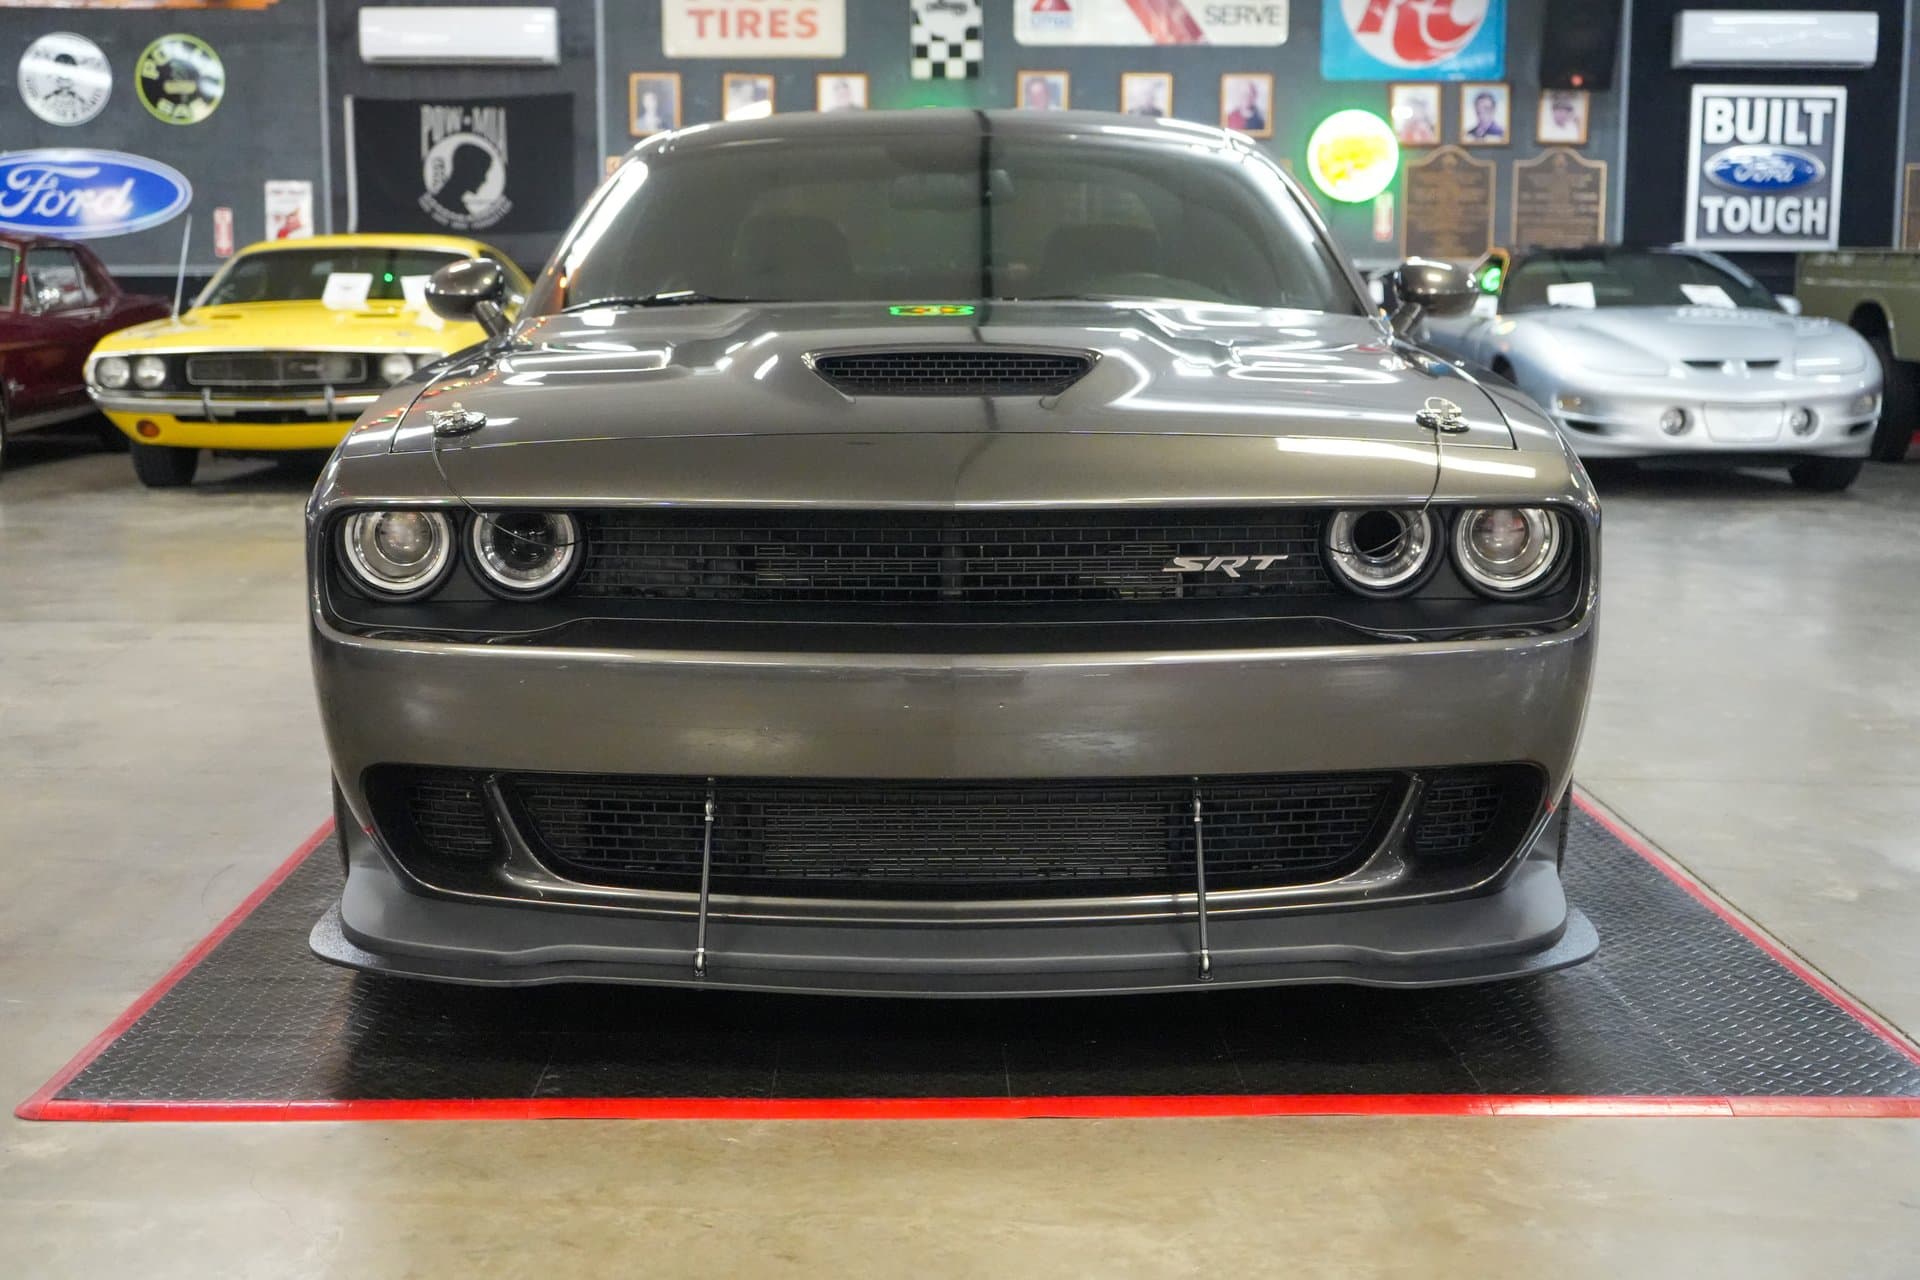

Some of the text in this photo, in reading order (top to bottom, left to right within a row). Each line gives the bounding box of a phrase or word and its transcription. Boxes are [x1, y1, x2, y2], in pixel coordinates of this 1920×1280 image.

[687, 8, 819, 38] TIRES
[1204, 5, 1281, 25] SERVE
[1703, 97, 1833, 145] BUILT
[1732, 154, 1796, 183] Ford
[0, 163, 136, 218] Ford
[1701, 196, 1827, 235] TOUGH
[1162, 555, 1288, 578] SRT
